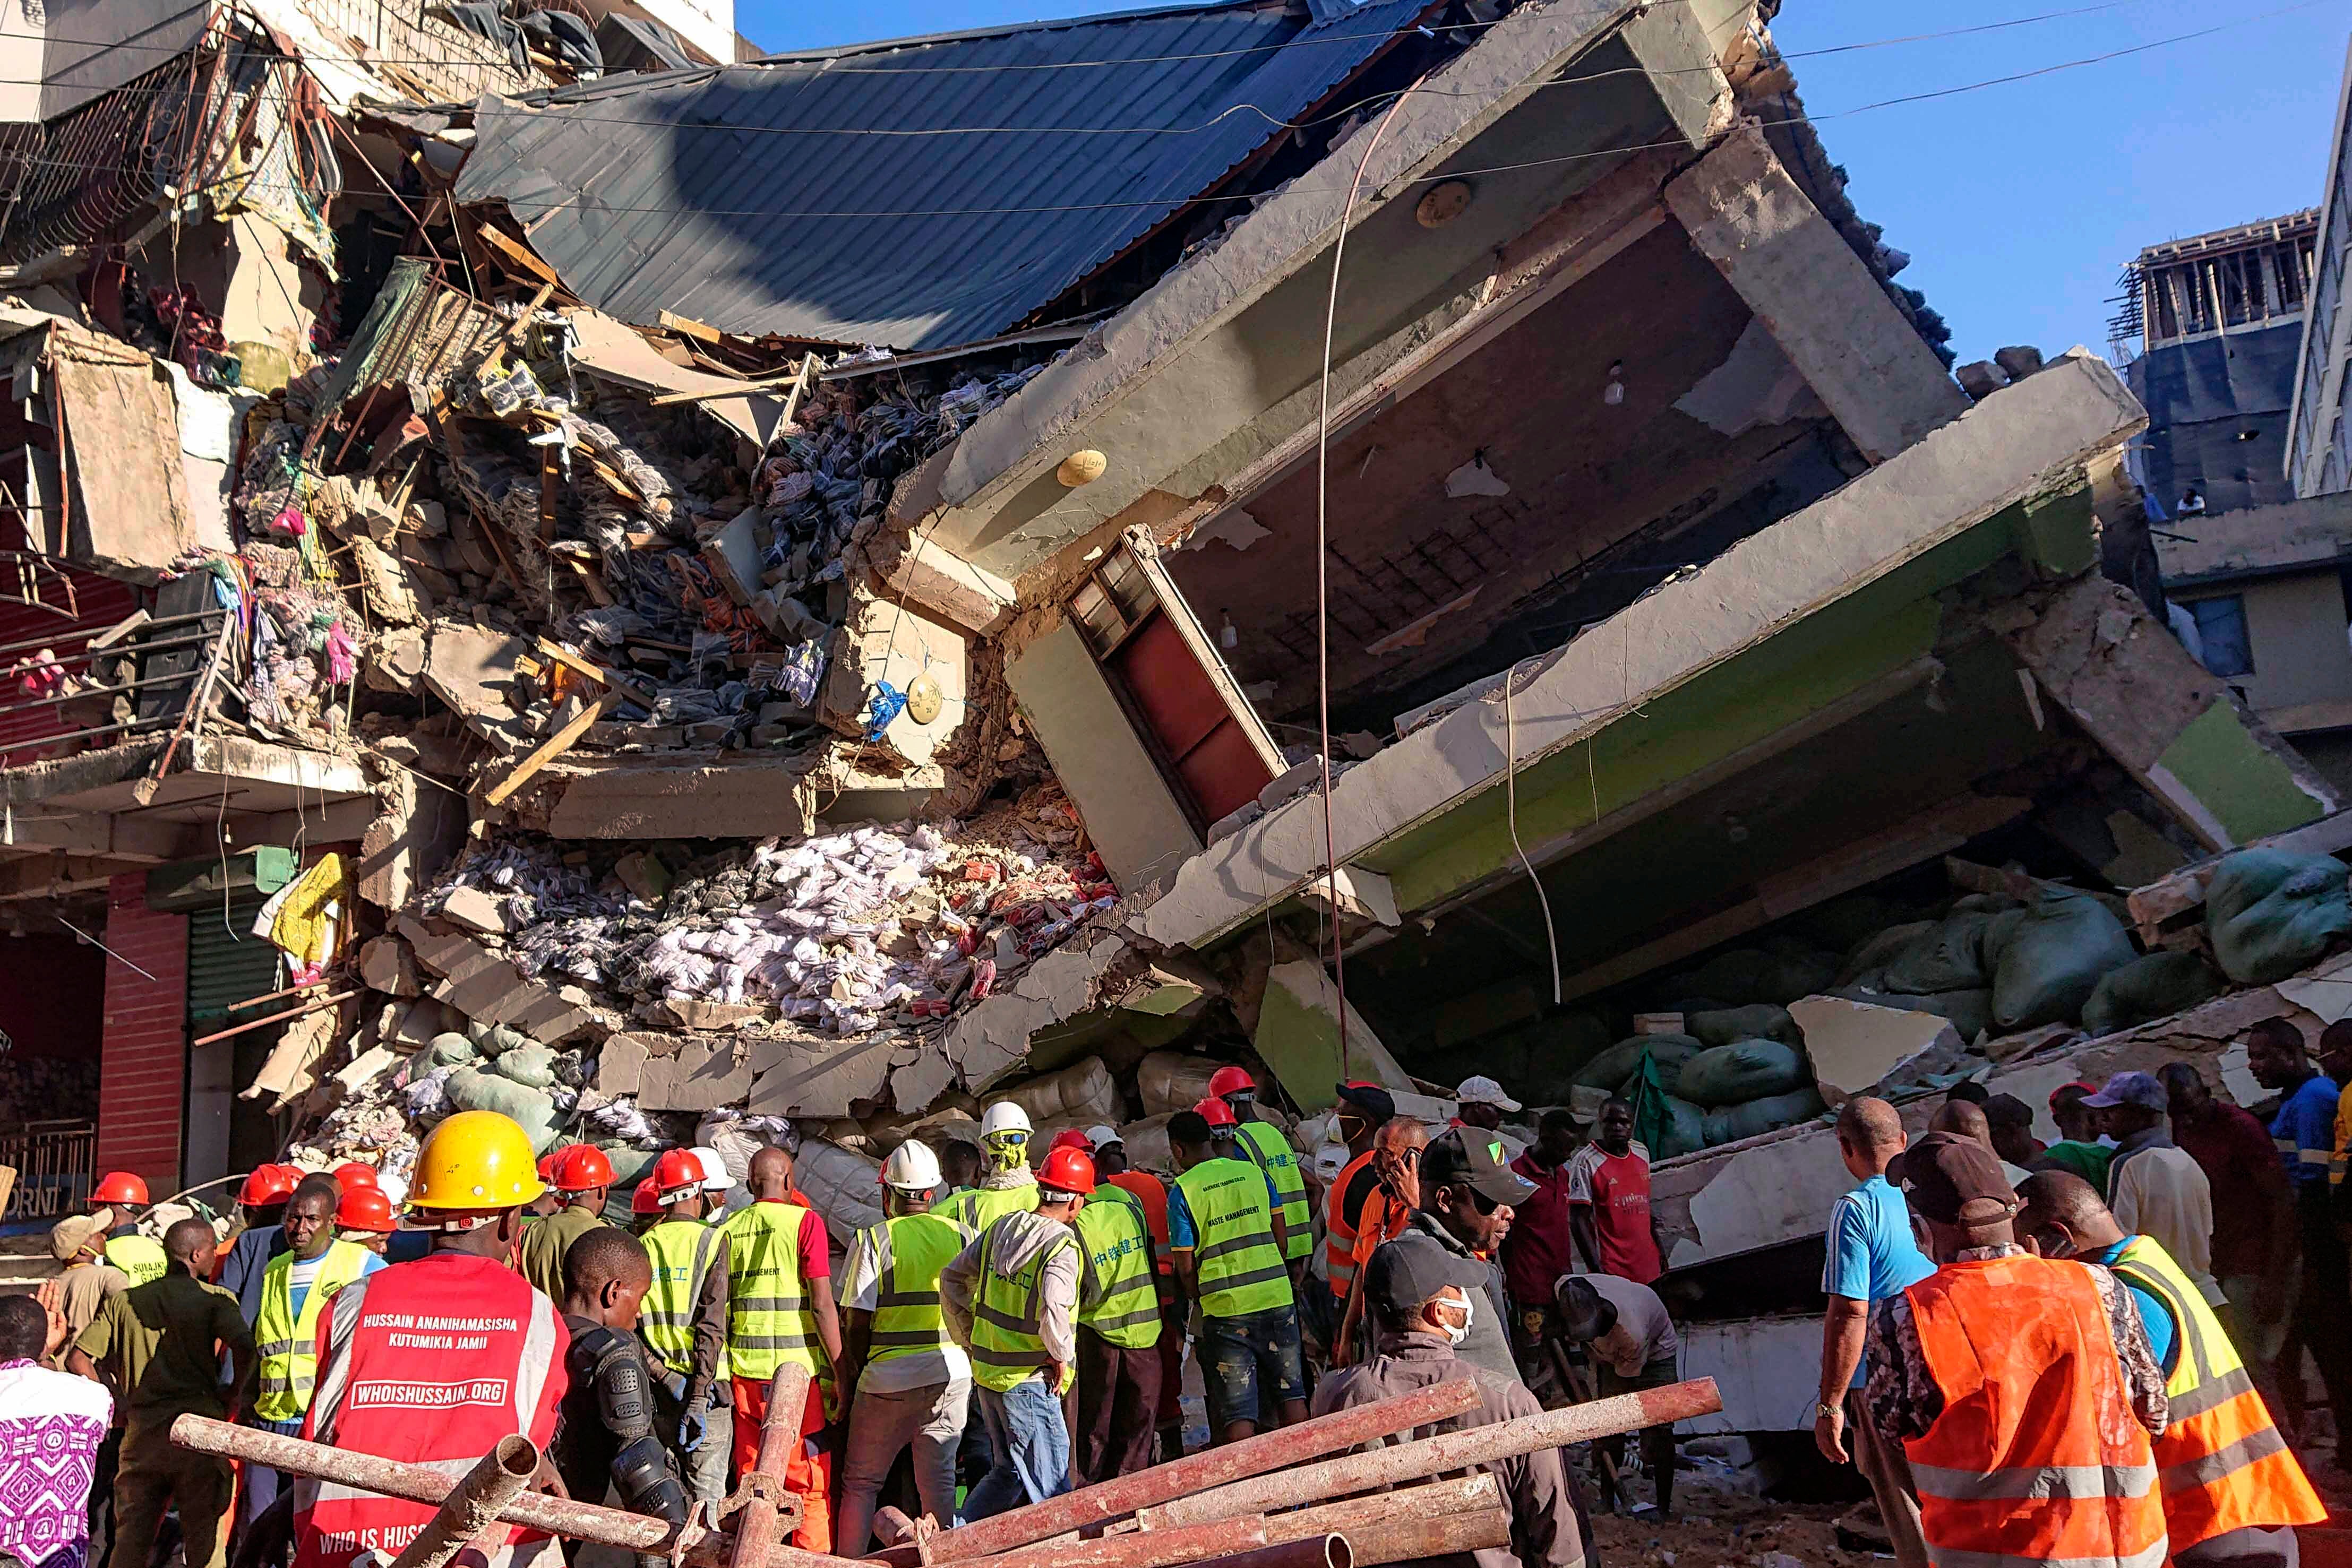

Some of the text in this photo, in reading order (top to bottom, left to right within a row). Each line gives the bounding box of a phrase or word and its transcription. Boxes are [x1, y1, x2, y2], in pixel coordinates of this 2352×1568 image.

[1207, 1205, 1260, 1228] WASTE MANAGEMENT
[1095, 1235, 1144, 1267] 中铁建工
[363, 1314, 517, 1331] HUSSAIN ANANIHAMASISHA
[389, 1333, 488, 1350] KUTUMIKIA JAMII
[357, 1383, 502, 1403] WHOISHUSSAIN.ORG
[320, 1530, 355, 1555] WHO
[361, 1528, 378, 1550] IS
